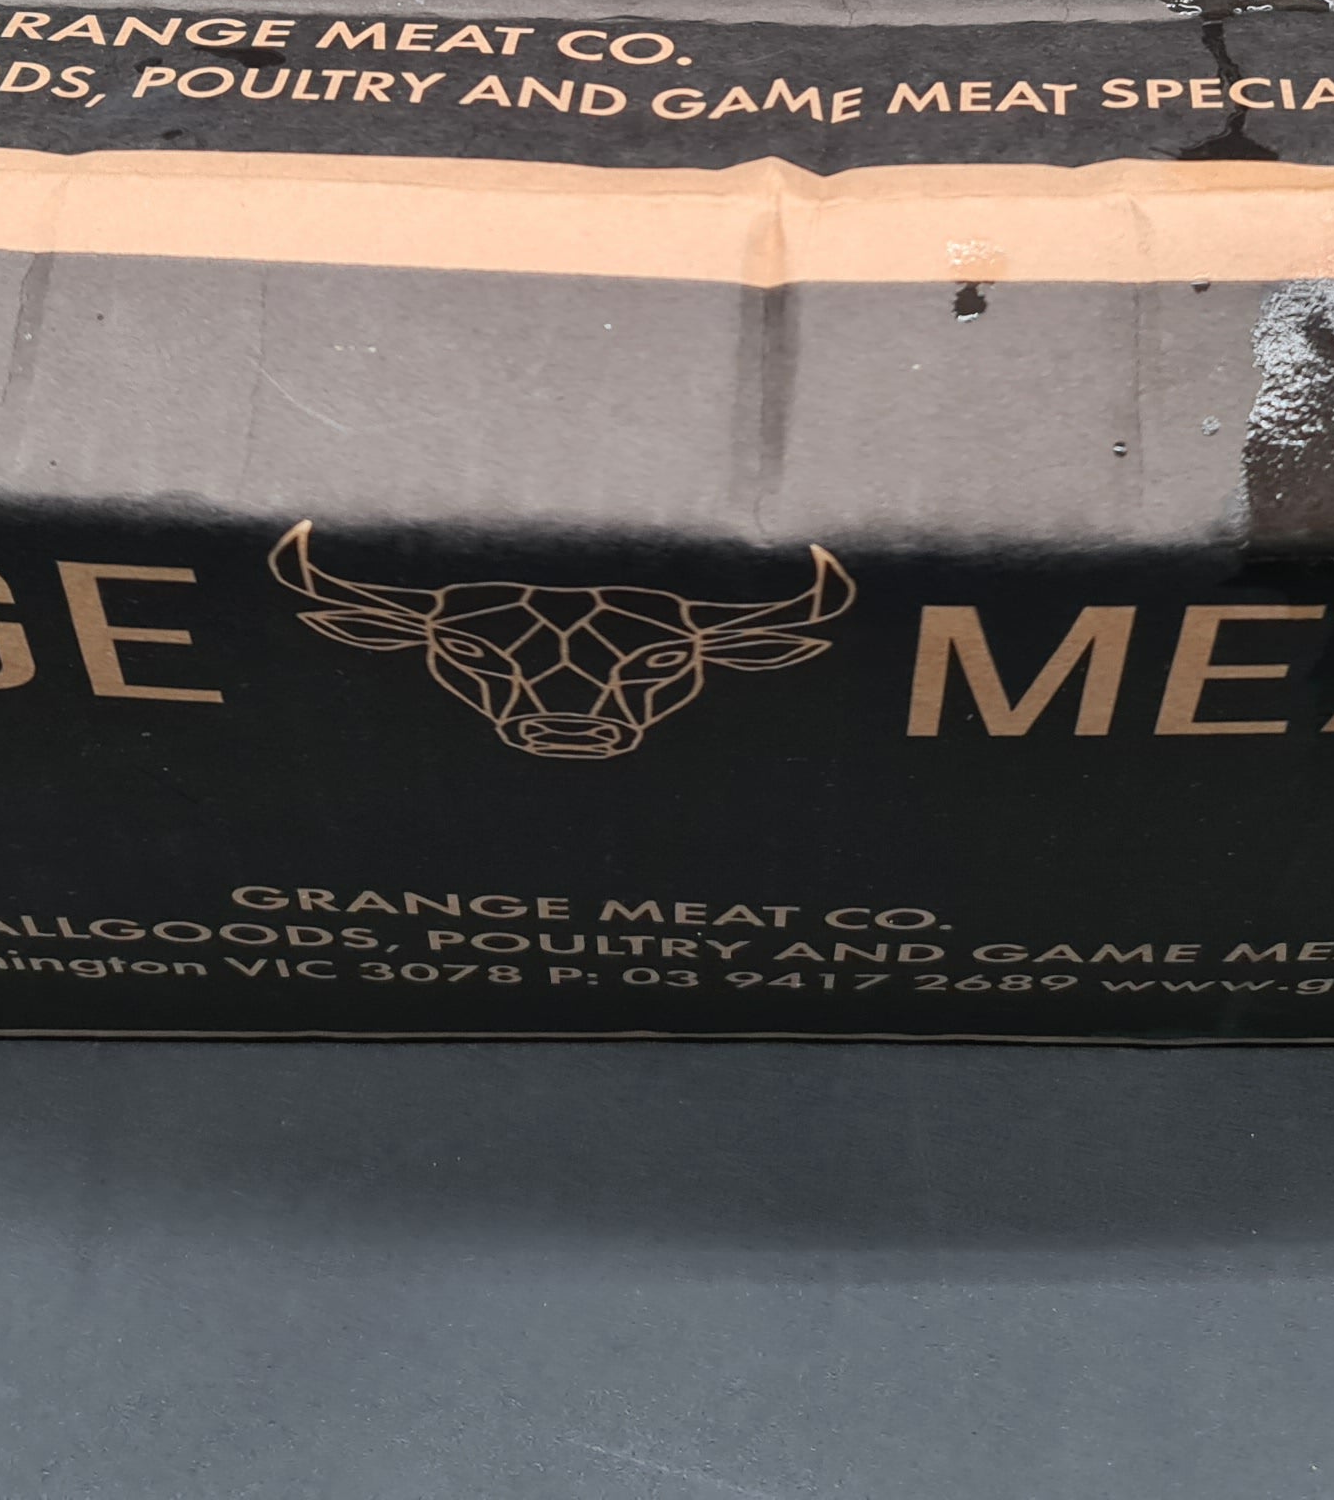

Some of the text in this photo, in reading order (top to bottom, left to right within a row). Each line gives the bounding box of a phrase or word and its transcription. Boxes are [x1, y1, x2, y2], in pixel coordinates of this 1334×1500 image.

[316, 20, 526, 58] MEAT
[556, 28, 694, 68] CO.
[130, 65, 448, 105] POULTRY
[457, 74, 631, 119] AND
[650, 77, 863, 125] GAME
[886, 80, 1078, 117] MEAT
[229, 883, 954, 933] GRANGE MEAT CO.
[425, 927, 752, 962] POULTRY
[771, 939, 947, 965] AND
[970, 941, 1203, 966] GAME
[222, 955, 339, 982] VIC
[358, 959, 525, 986] 3078
[547, 964, 600, 988] P:
[620, 965, 701, 990] 03
[723, 969, 891, 992] 9417
[913, 972, 1080, 993] 2689
